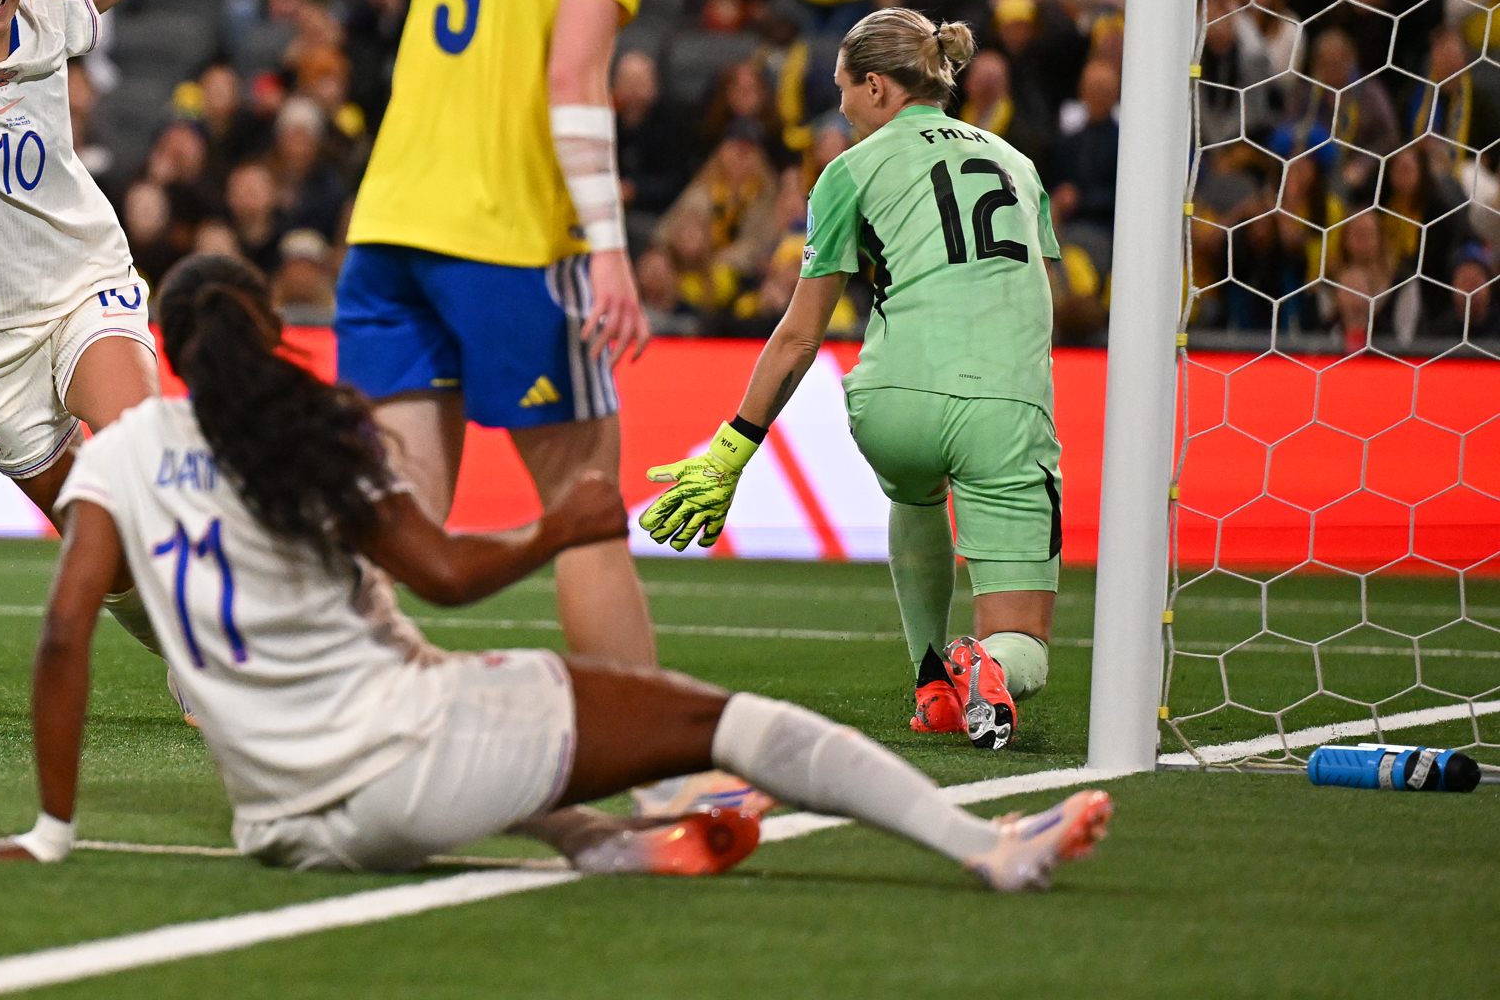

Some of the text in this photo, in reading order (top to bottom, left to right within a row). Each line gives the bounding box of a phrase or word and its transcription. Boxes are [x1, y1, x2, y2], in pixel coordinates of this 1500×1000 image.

[919, 127, 989, 144] FALK
[930, 158, 1029, 264] 12
[720, 437, 738, 453] Falk
[153, 518, 247, 669] 11
